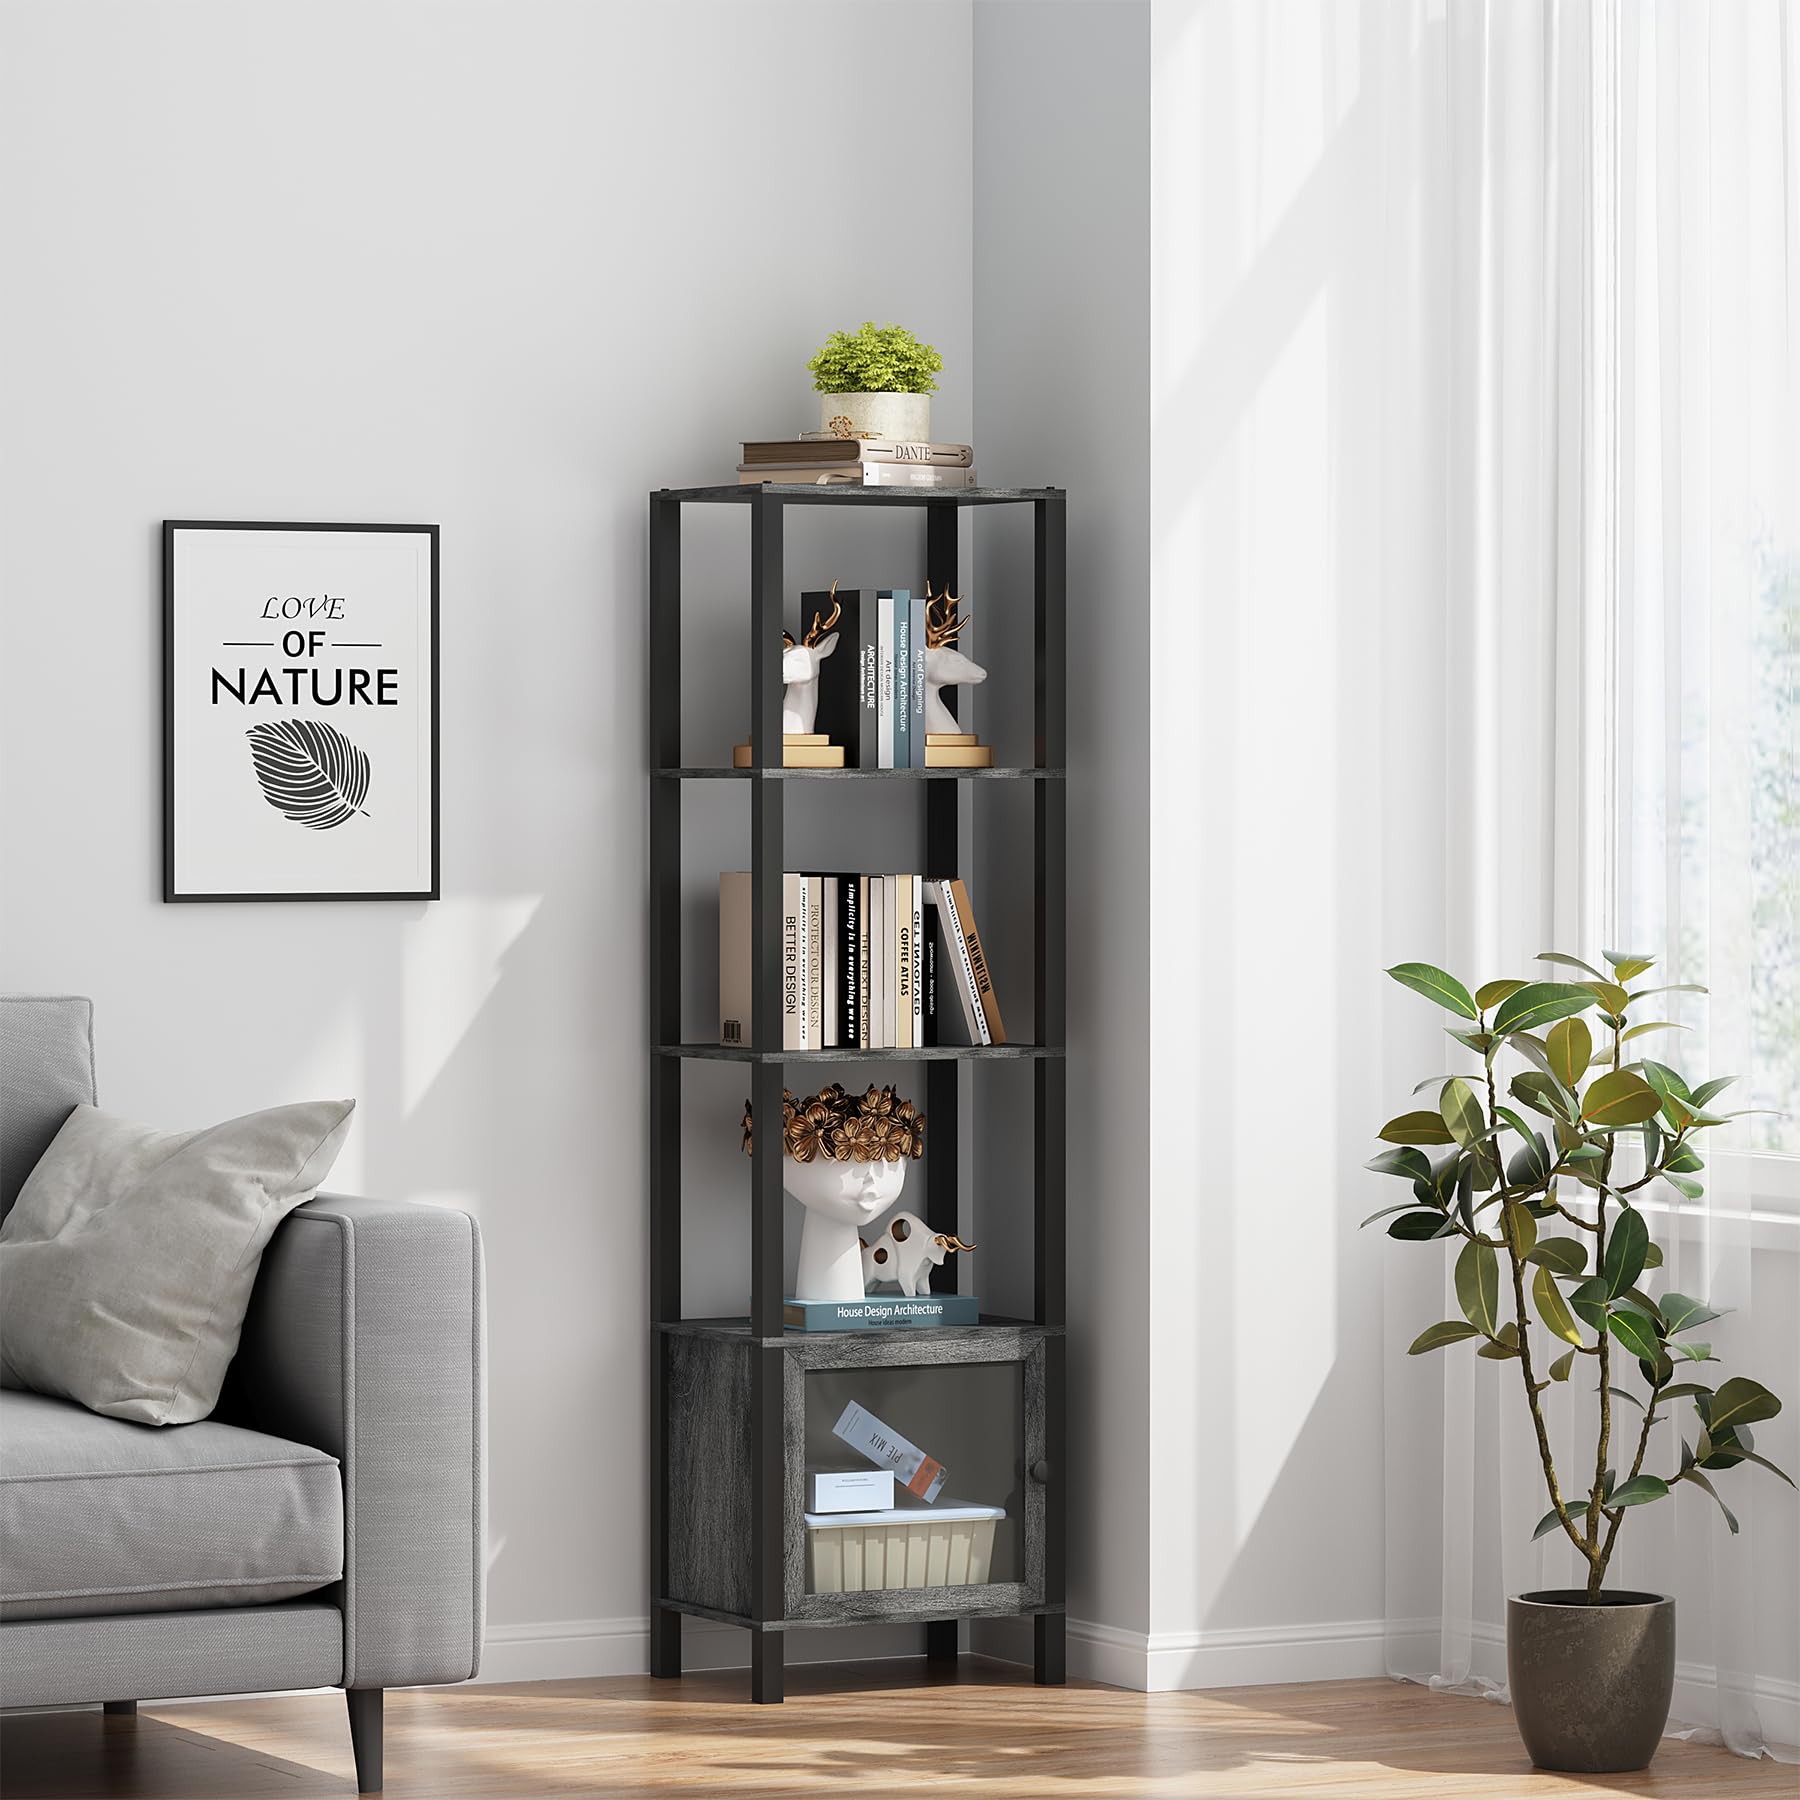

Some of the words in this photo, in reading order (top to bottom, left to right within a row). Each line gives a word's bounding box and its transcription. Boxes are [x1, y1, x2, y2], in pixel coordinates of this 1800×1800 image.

[896, 445, 930, 461] DANTE
[260, 594, 345, 619] LOVE
[282, 631, 326, 658] OF
[899, 650, 907, 679] Design
[918, 664, 924, 672] of
[212, 667, 398, 706] NATURE
[847, 884, 855, 929] simplicity
[786, 916, 796, 961] BETTER
[811, 905, 819, 957] PROTECT
[802, 947, 806, 955] in
[849, 944, 855, 952] in
[811, 958, 819, 985] OUR
[847, 956, 855, 1005] everything
[786, 966, 796, 1014] DESIGN
[802, 1010, 805, 1021] we
[811, 987, 819, 1028] DESIGN
[849, 1009, 855, 1020] we
[837, 1306, 863, 1317] House
[865, 1306, 892, 1319] Design
[894, 1304, 943, 1316] Architecture
[869, 1433, 888, 1450] MIX
[886, 1445, 903, 1464] PIE
